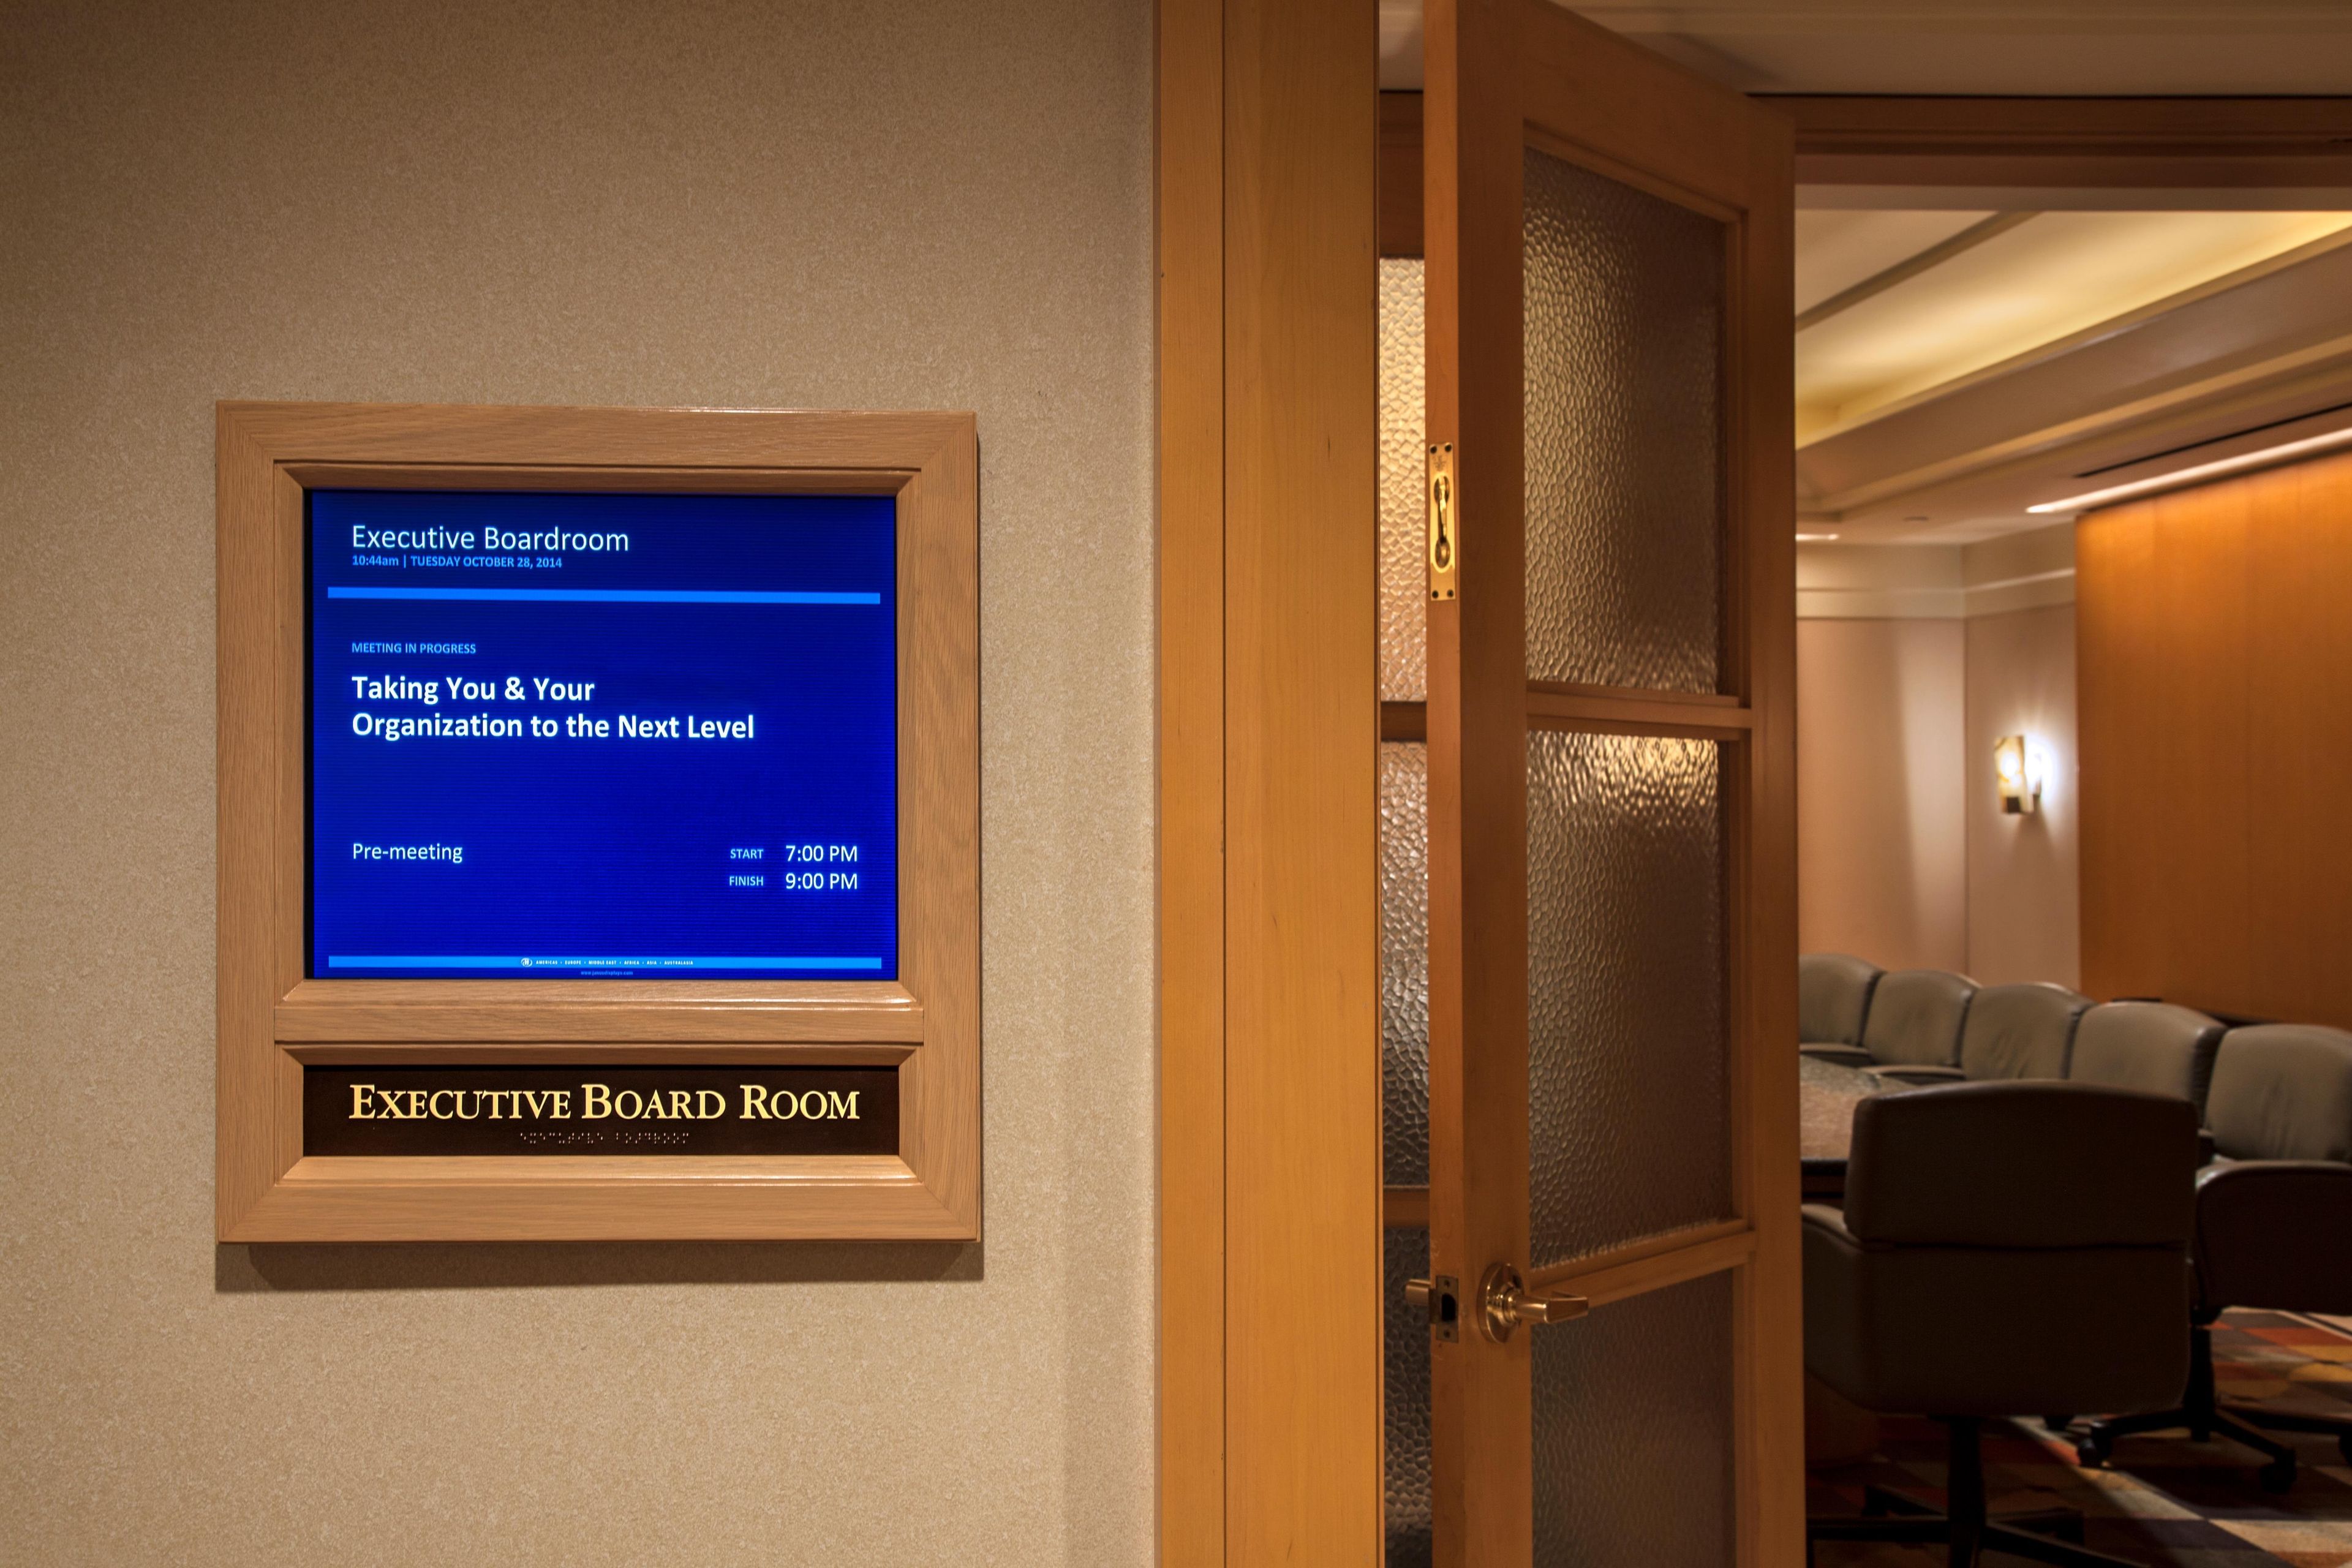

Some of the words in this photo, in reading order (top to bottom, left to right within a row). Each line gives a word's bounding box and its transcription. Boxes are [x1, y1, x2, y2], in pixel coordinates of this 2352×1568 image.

[352, 525, 475, 550] Executive
[484, 526, 629, 551] Boardroom
[352, 555, 399, 567] 10:44am
[410, 556, 461, 567] TUESDAY
[463, 556, 514, 568] OCTOBER
[517, 557, 533, 570] 28,
[536, 557, 563, 568] 2014
[352, 643, 402, 654] MEETING
[405, 643, 417, 654] IN
[420, 643, 477, 655] PROGRESS
[351, 674, 439, 705] Taking
[445, 676, 496, 701] You
[504, 676, 526, 701] &
[533, 677, 595, 702] Your
[352, 712, 523, 742] Organization
[530, 715, 559, 738] to
[565, 713, 610, 739] the
[618, 714, 680, 739] Next
[687, 714, 755, 739] Level
[353, 842, 463, 864] Pre-meeting
[729, 848, 764, 860] START
[785, 845, 824, 862] 7:00
[829, 845, 858, 862] PM
[729, 875, 764, 887] FINISH
[785, 872, 824, 890] 9:00
[829, 873, 858, 890] PM
[349, 1084, 571, 1120] EXECUTIVE
[581, 1084, 726, 1120] BOARD
[739, 1084, 861, 1120] ROOM
